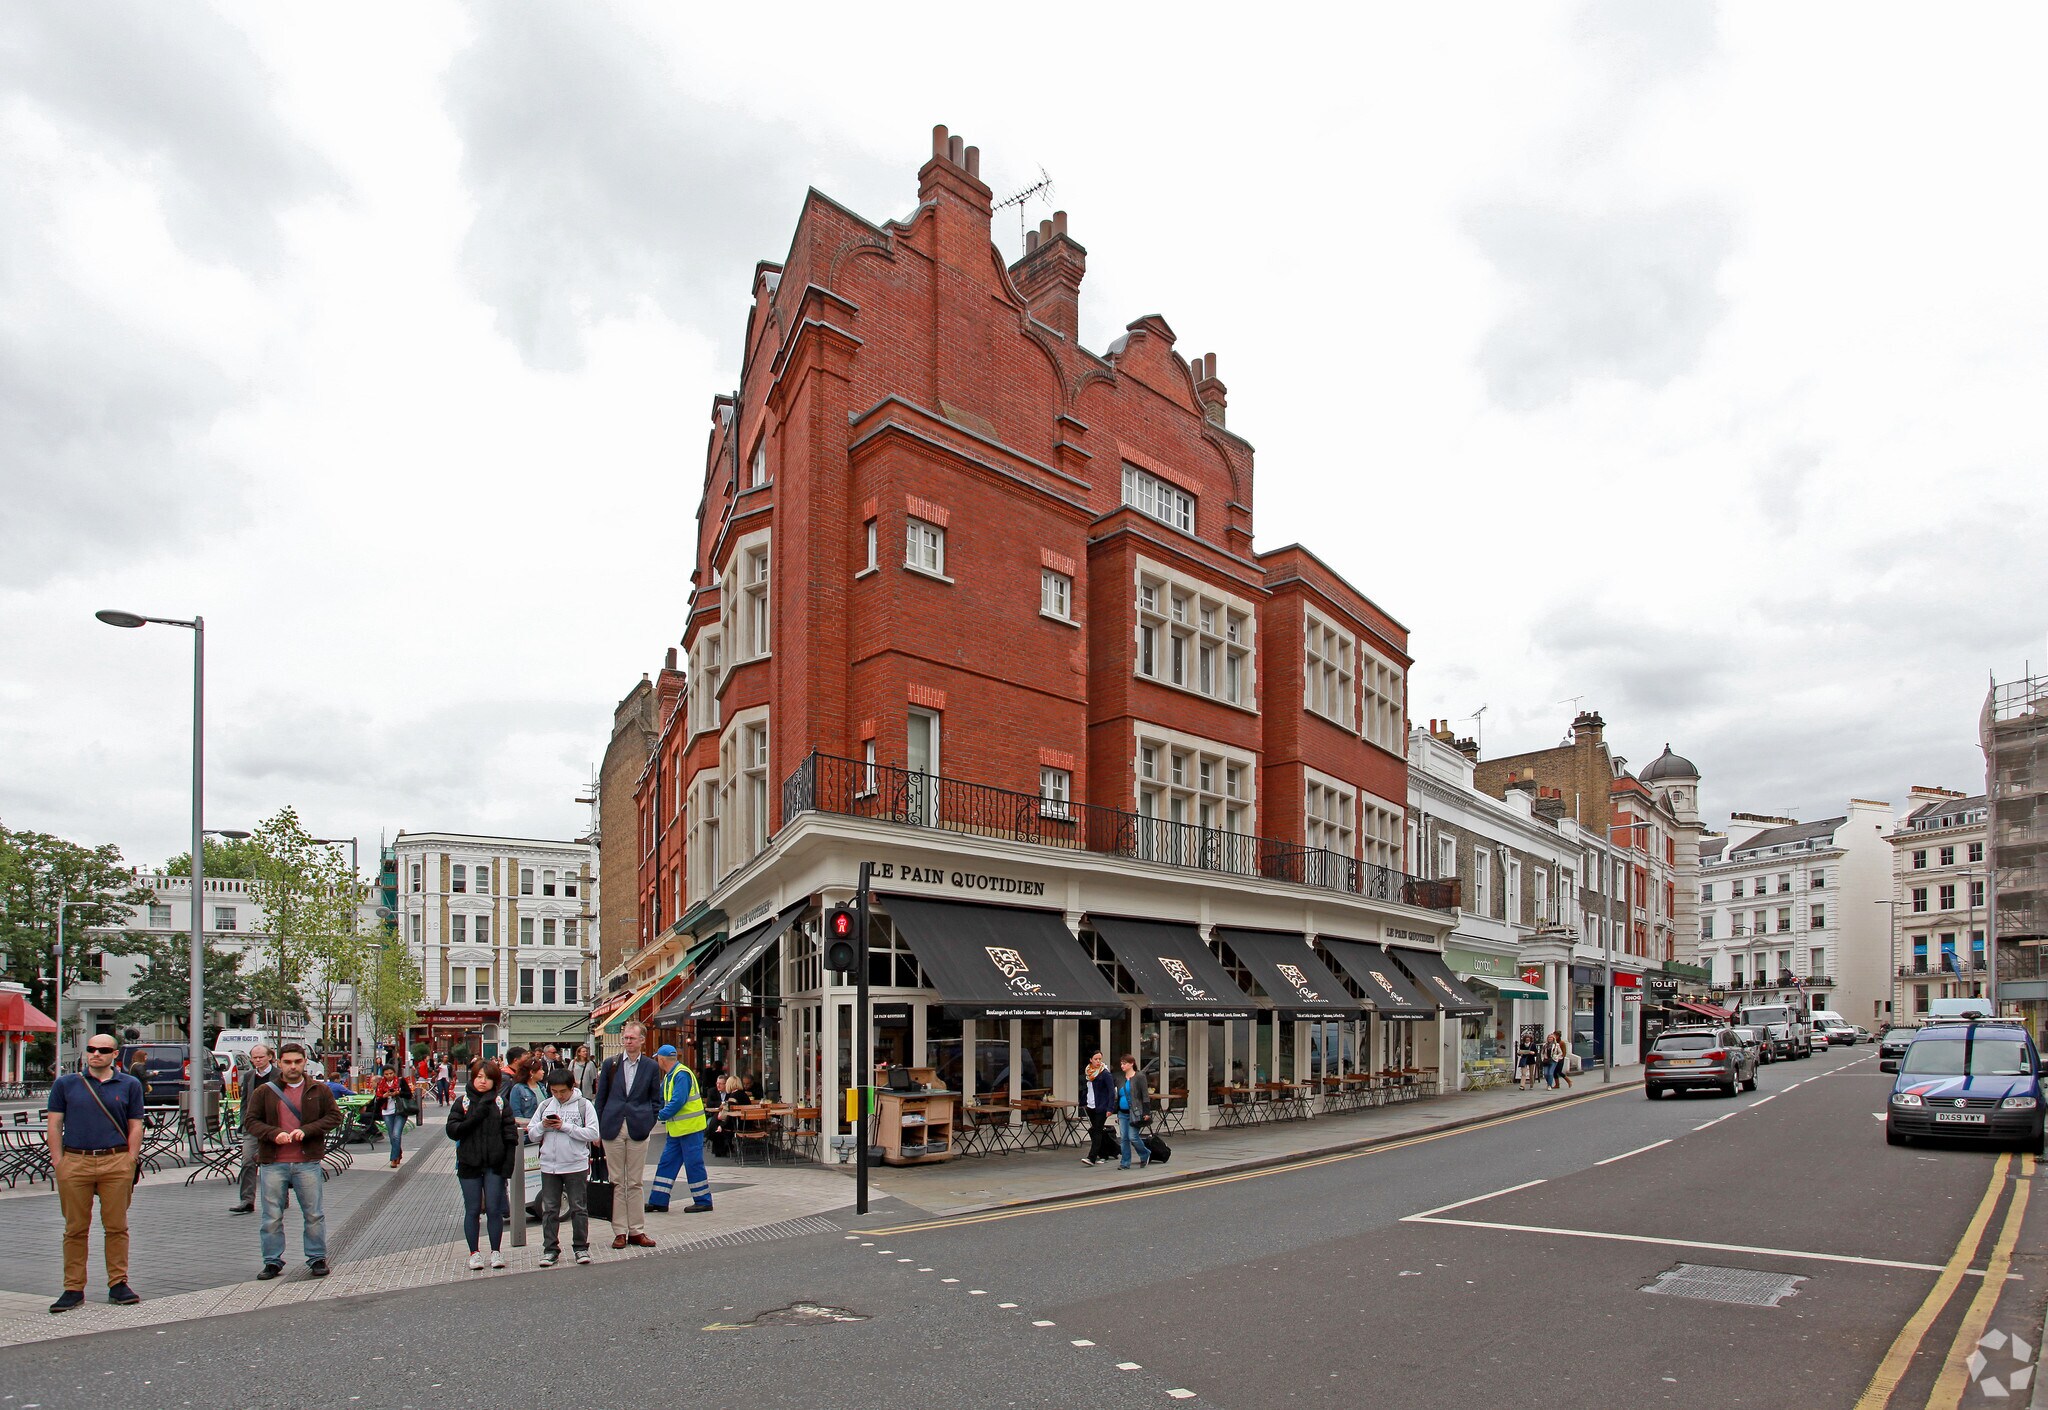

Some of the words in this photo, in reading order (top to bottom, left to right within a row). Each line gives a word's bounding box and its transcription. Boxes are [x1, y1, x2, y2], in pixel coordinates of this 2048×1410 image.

[869, 861, 894, 879] LE
[900, 865, 945, 884] PAIN
[951, 871, 1045, 896] QUOTIDIEN
[1011, 976, 1041, 991] Pain
[1939, 1113, 1962, 1121] DX59
